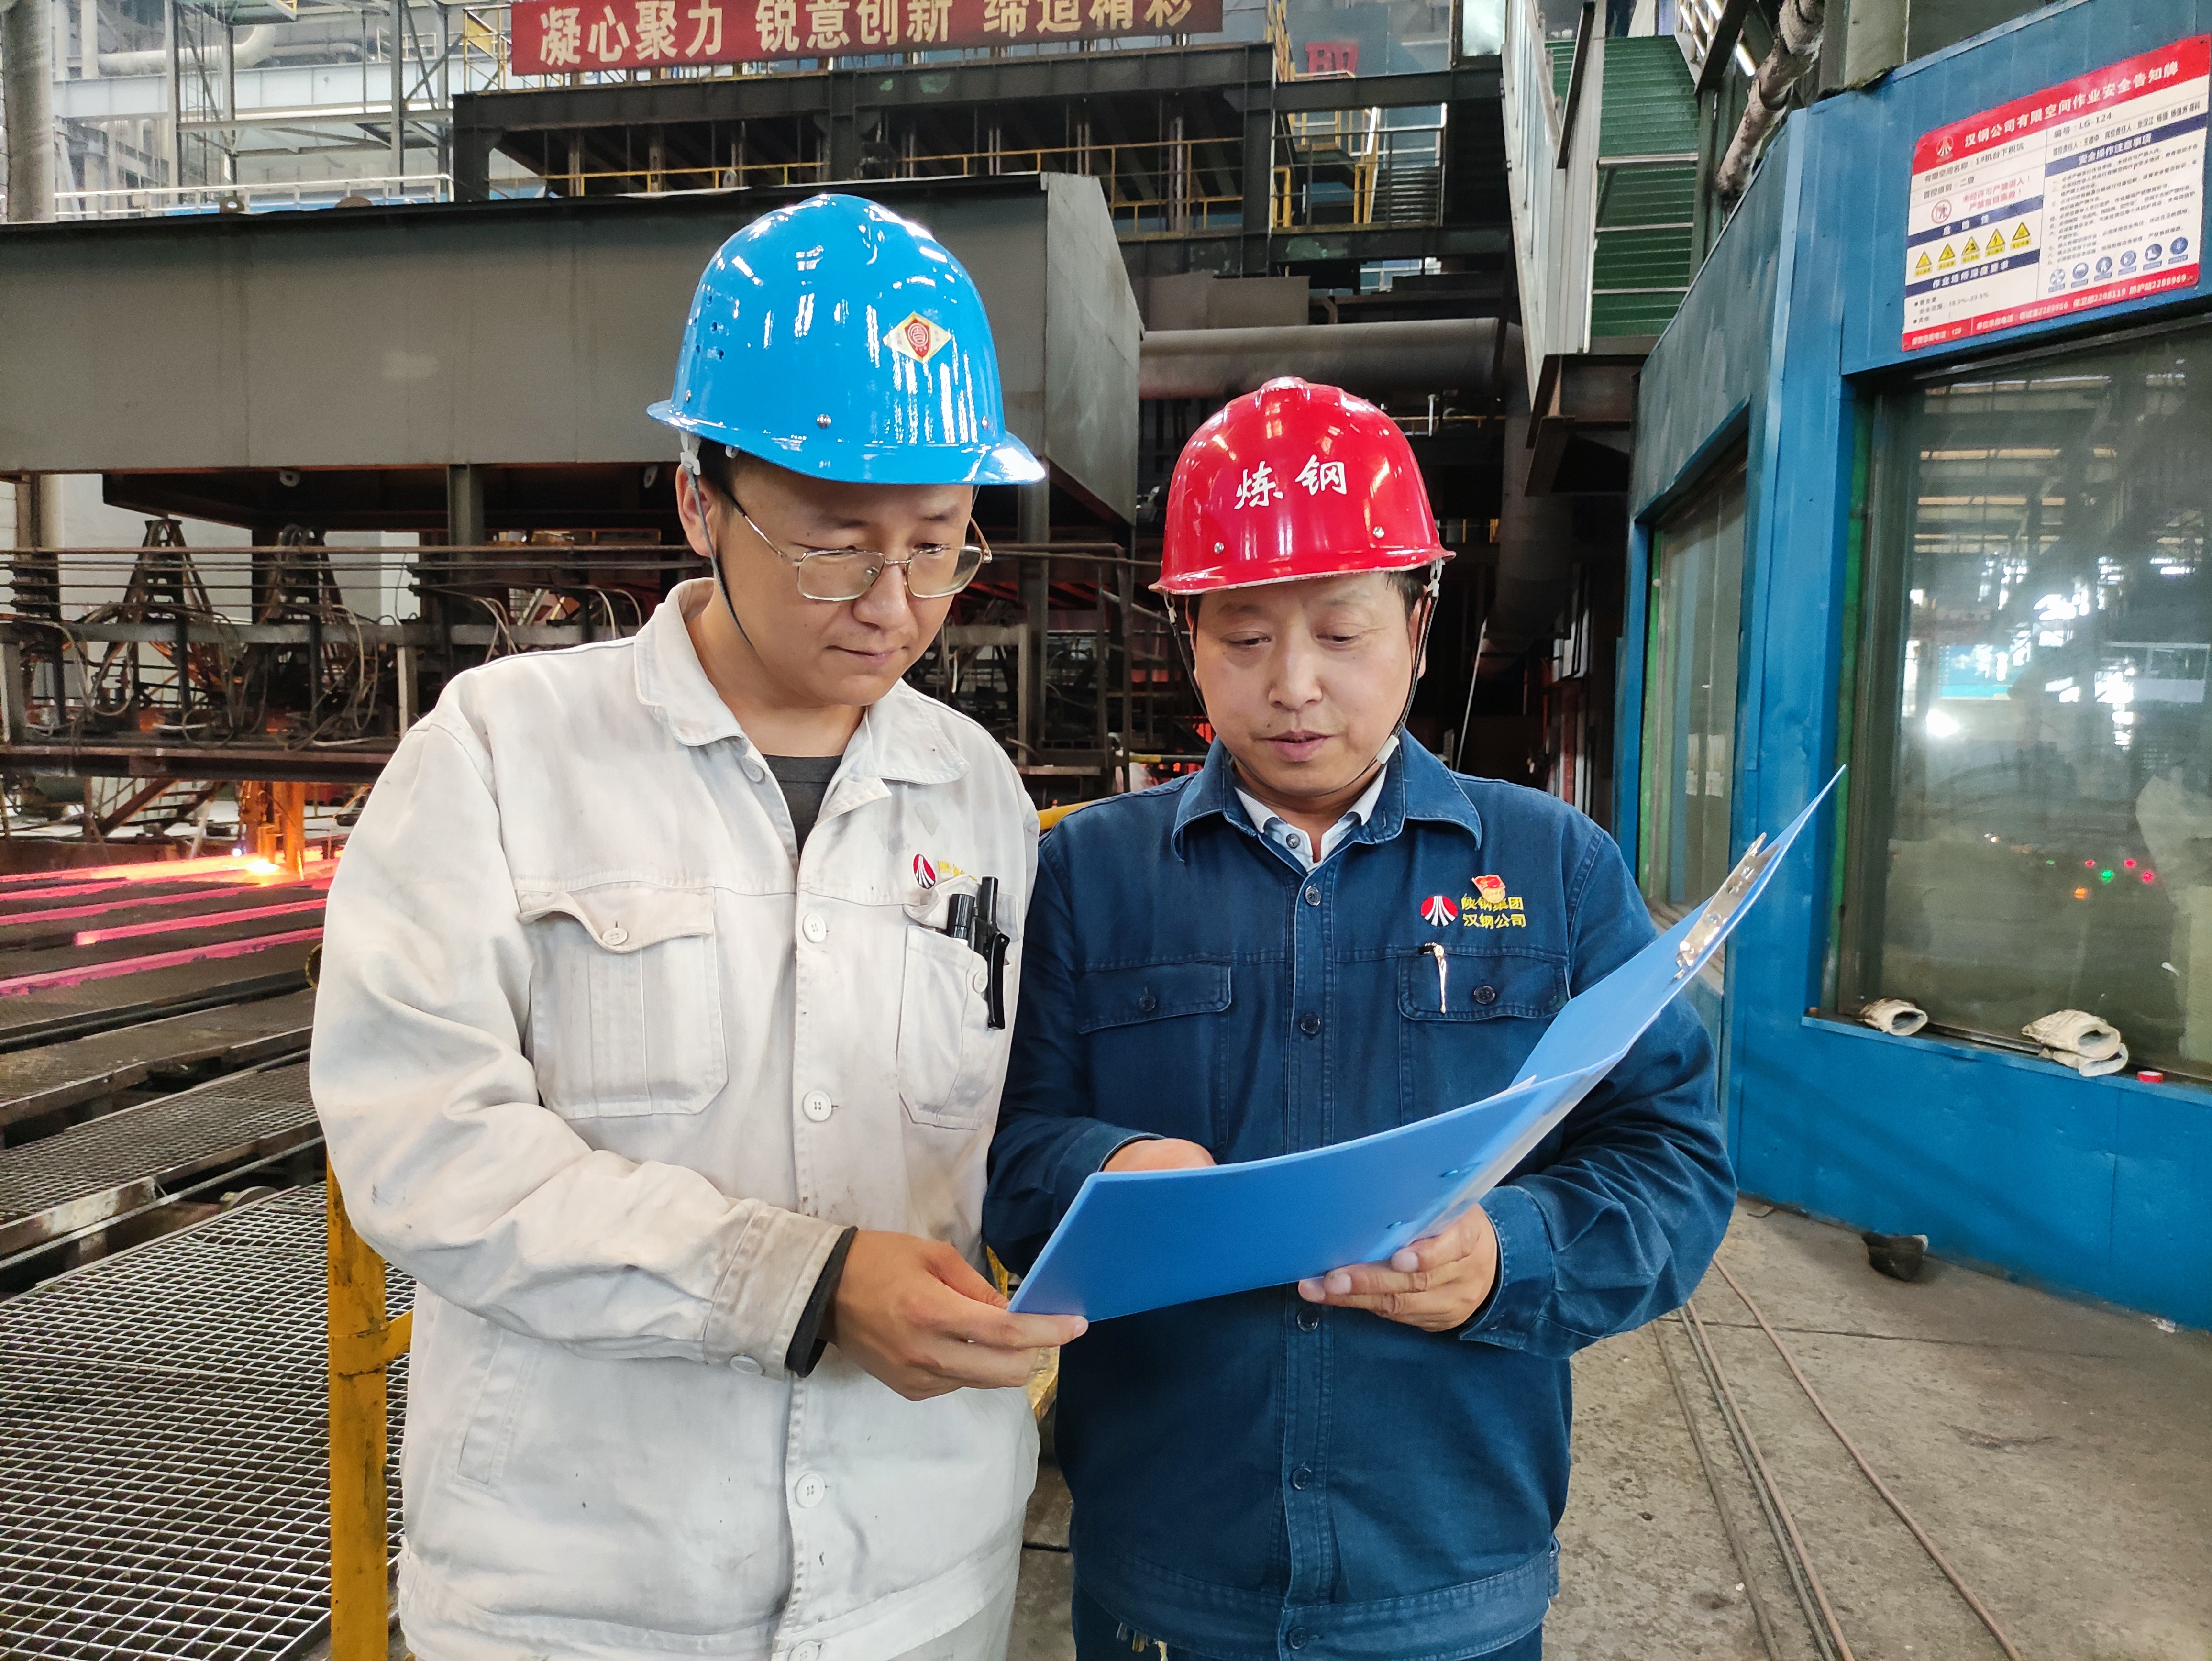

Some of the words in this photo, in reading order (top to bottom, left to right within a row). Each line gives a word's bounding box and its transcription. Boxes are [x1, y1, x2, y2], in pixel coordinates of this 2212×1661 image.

[539, 0, 723, 66] 凝心聚力
[755, 0, 951, 52] 锐意创新
[1965, 61, 2179, 148] 汉钢公司有限空间作业安全告知牌
[1234, 454, 1347, 509] 炼钢
[1462, 913, 1526, 929] 汉钢公司
